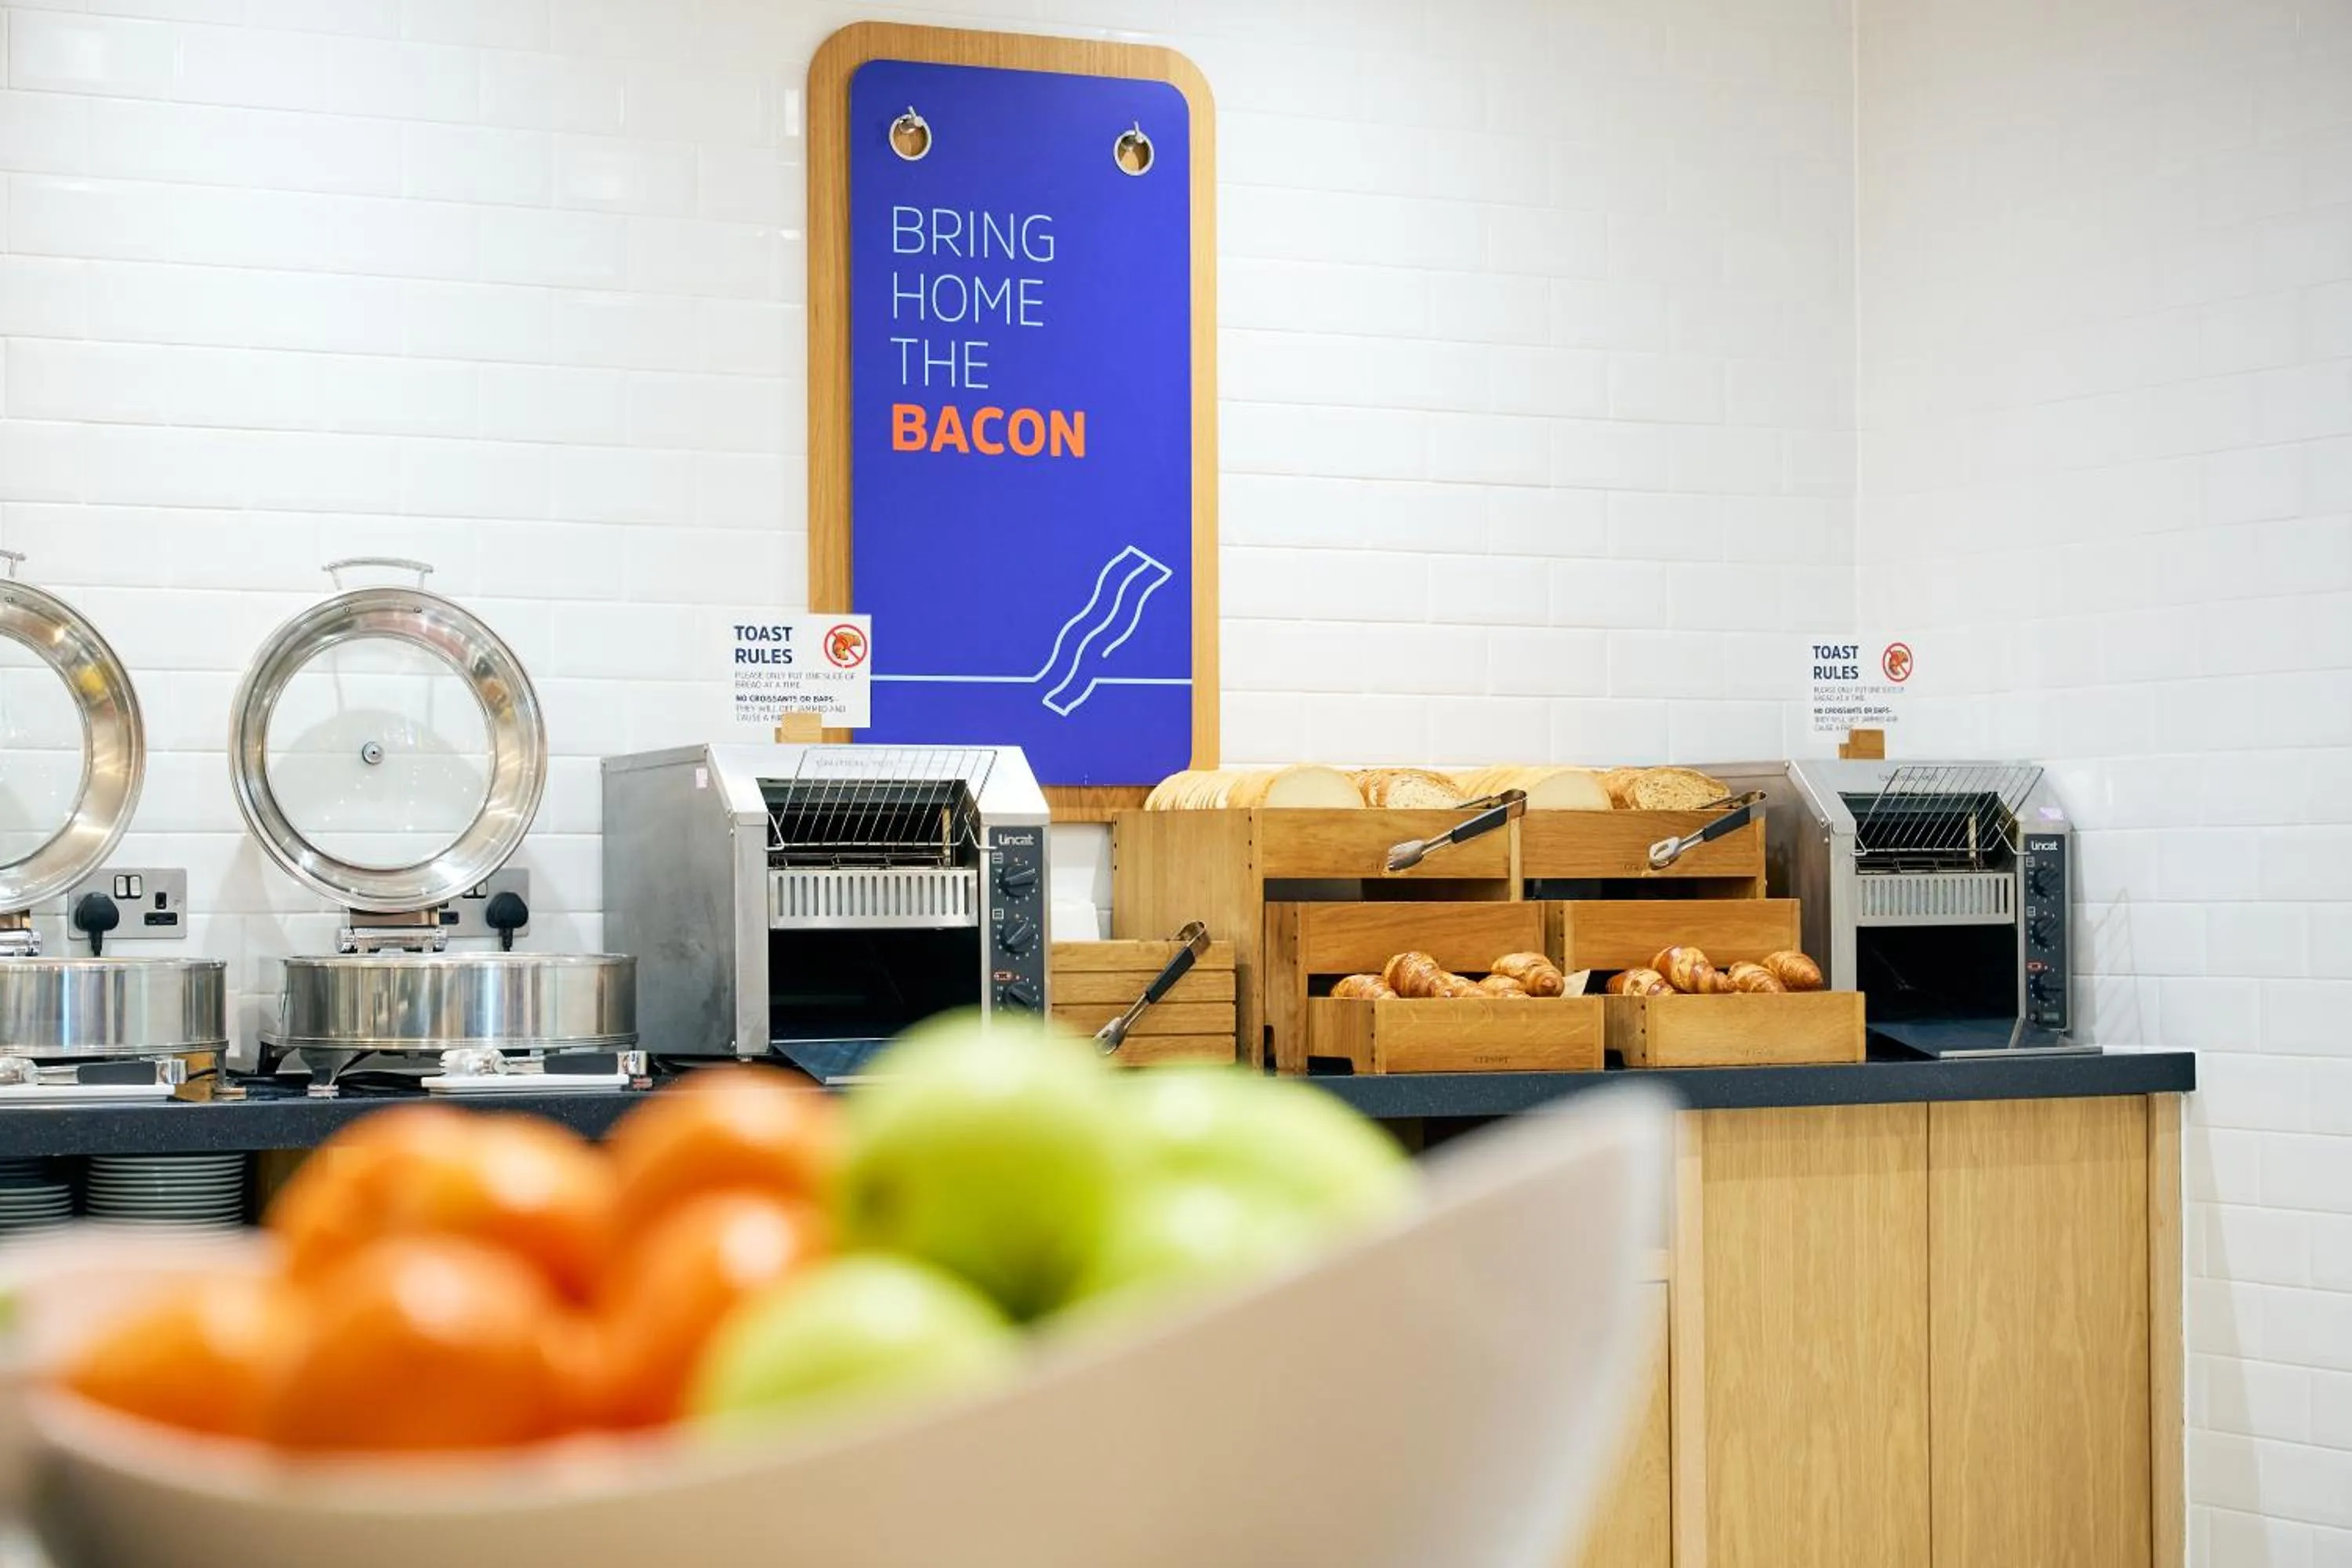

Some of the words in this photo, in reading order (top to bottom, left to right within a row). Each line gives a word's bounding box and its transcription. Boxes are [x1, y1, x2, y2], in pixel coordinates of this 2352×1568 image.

[892, 205, 1054, 263] BRING
[892, 271, 1044, 328] HOME
[890, 337, 989, 389] THE
[892, 402, 1086, 459] BACON
[734, 625, 793, 642] TOAST
[735, 648, 793, 664] RULES
[1813, 645, 1859, 659] TOAST
[1813, 666, 1859, 680] RULES
